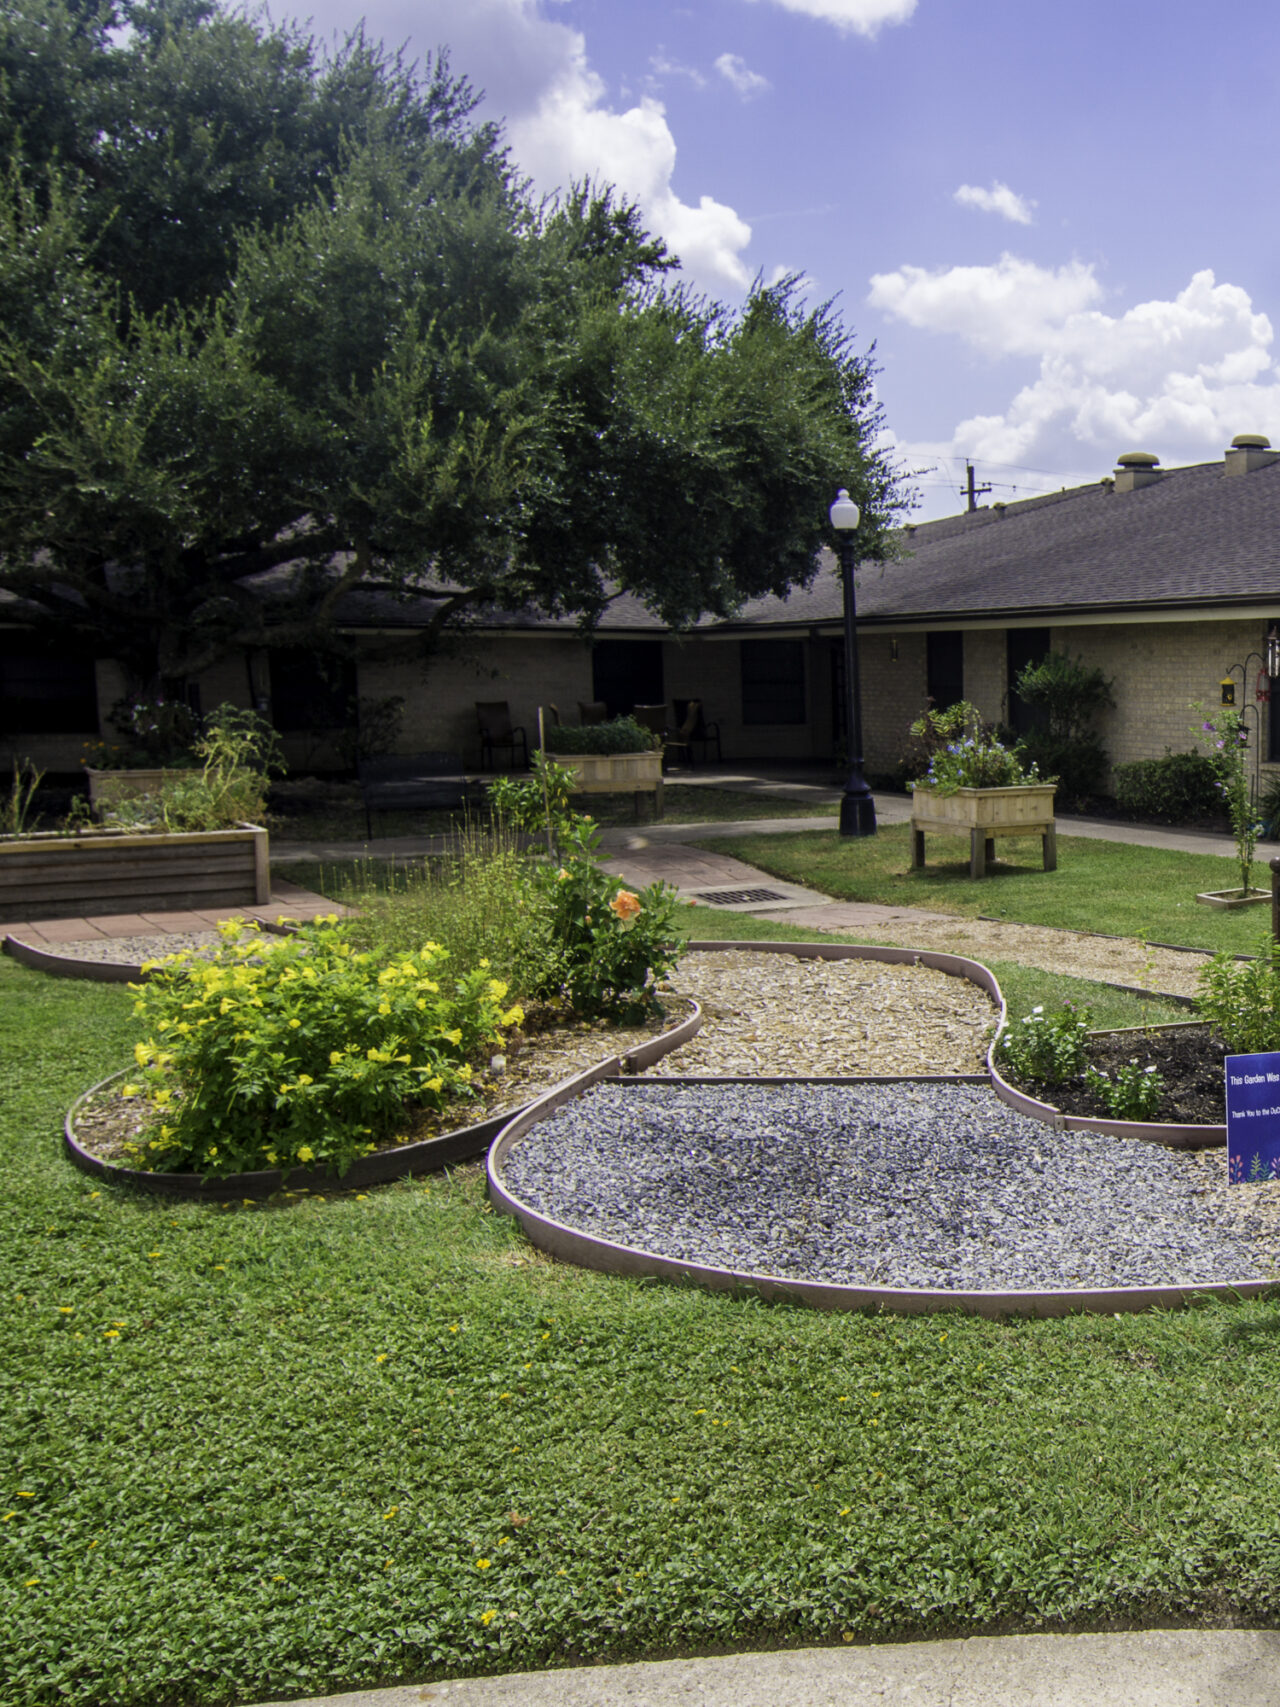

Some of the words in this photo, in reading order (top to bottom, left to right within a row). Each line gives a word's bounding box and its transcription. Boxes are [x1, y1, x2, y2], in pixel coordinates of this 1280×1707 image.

[1230, 1076, 1242, 1085] This
[1244, 1074, 1265, 1084] Garden
[1266, 1072, 1280, 1082] Was
